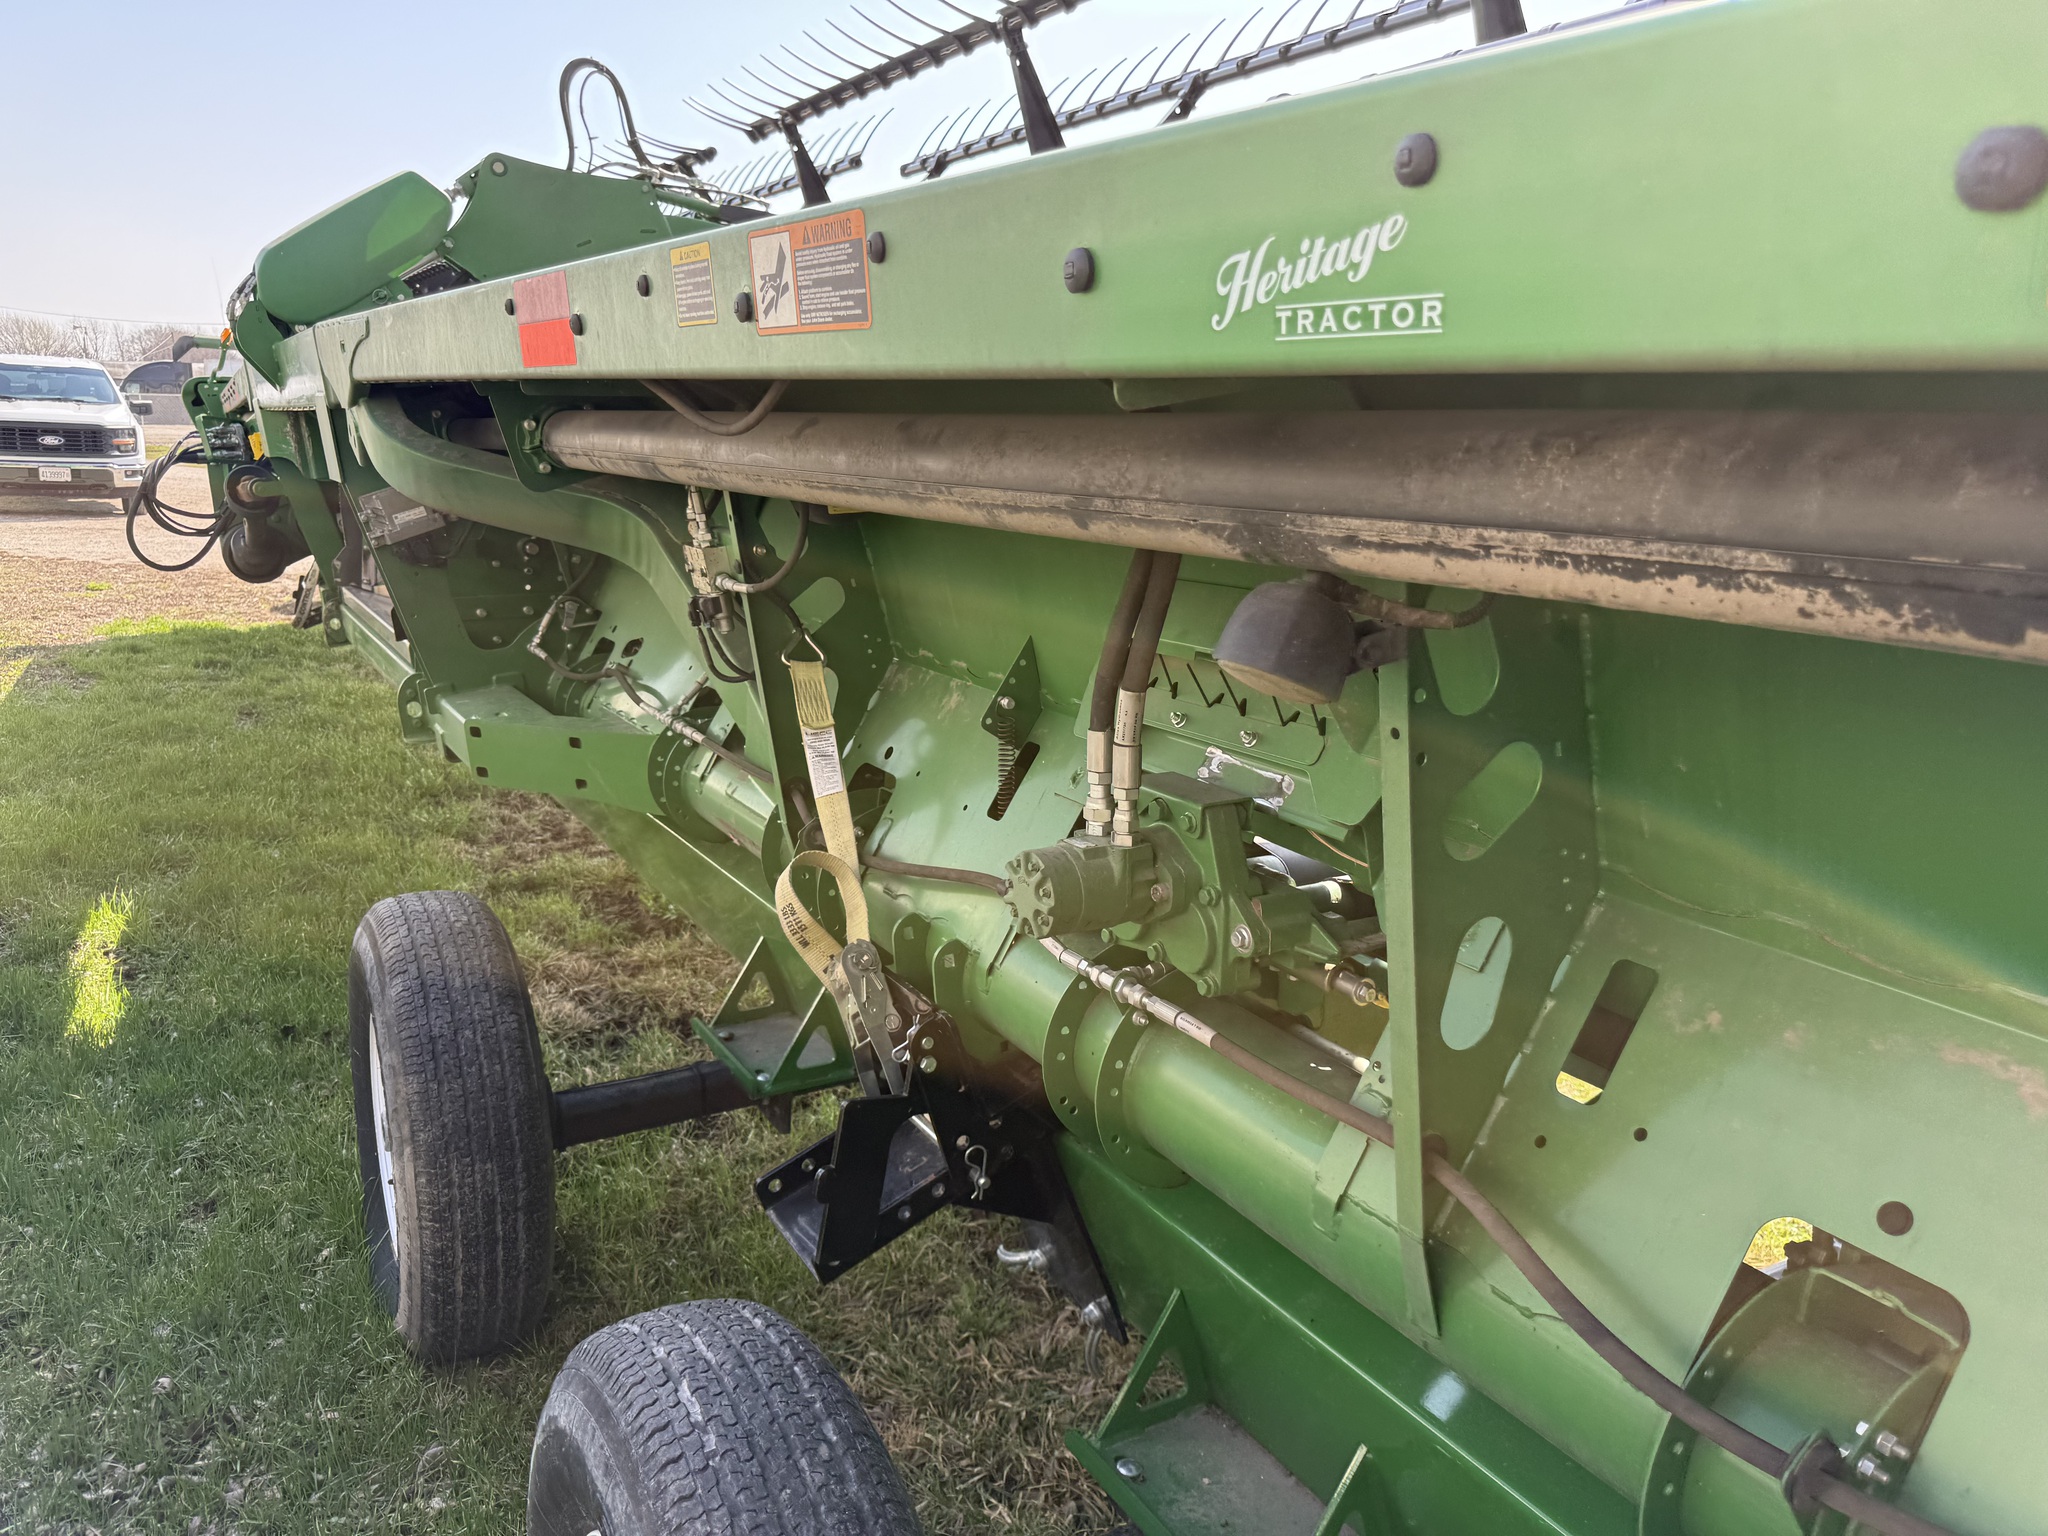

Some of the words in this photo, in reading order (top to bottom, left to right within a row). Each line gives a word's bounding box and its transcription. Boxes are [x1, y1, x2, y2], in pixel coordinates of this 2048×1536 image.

[811, 218, 852, 243] WARNING
[684, 249, 701, 260] CAUTION
[1211, 213, 1408, 331] Heritage
[1276, 300, 1443, 334] TRACTOR
[781, 907, 791, 920] LBS
[786, 902, 797, 916] KGS
